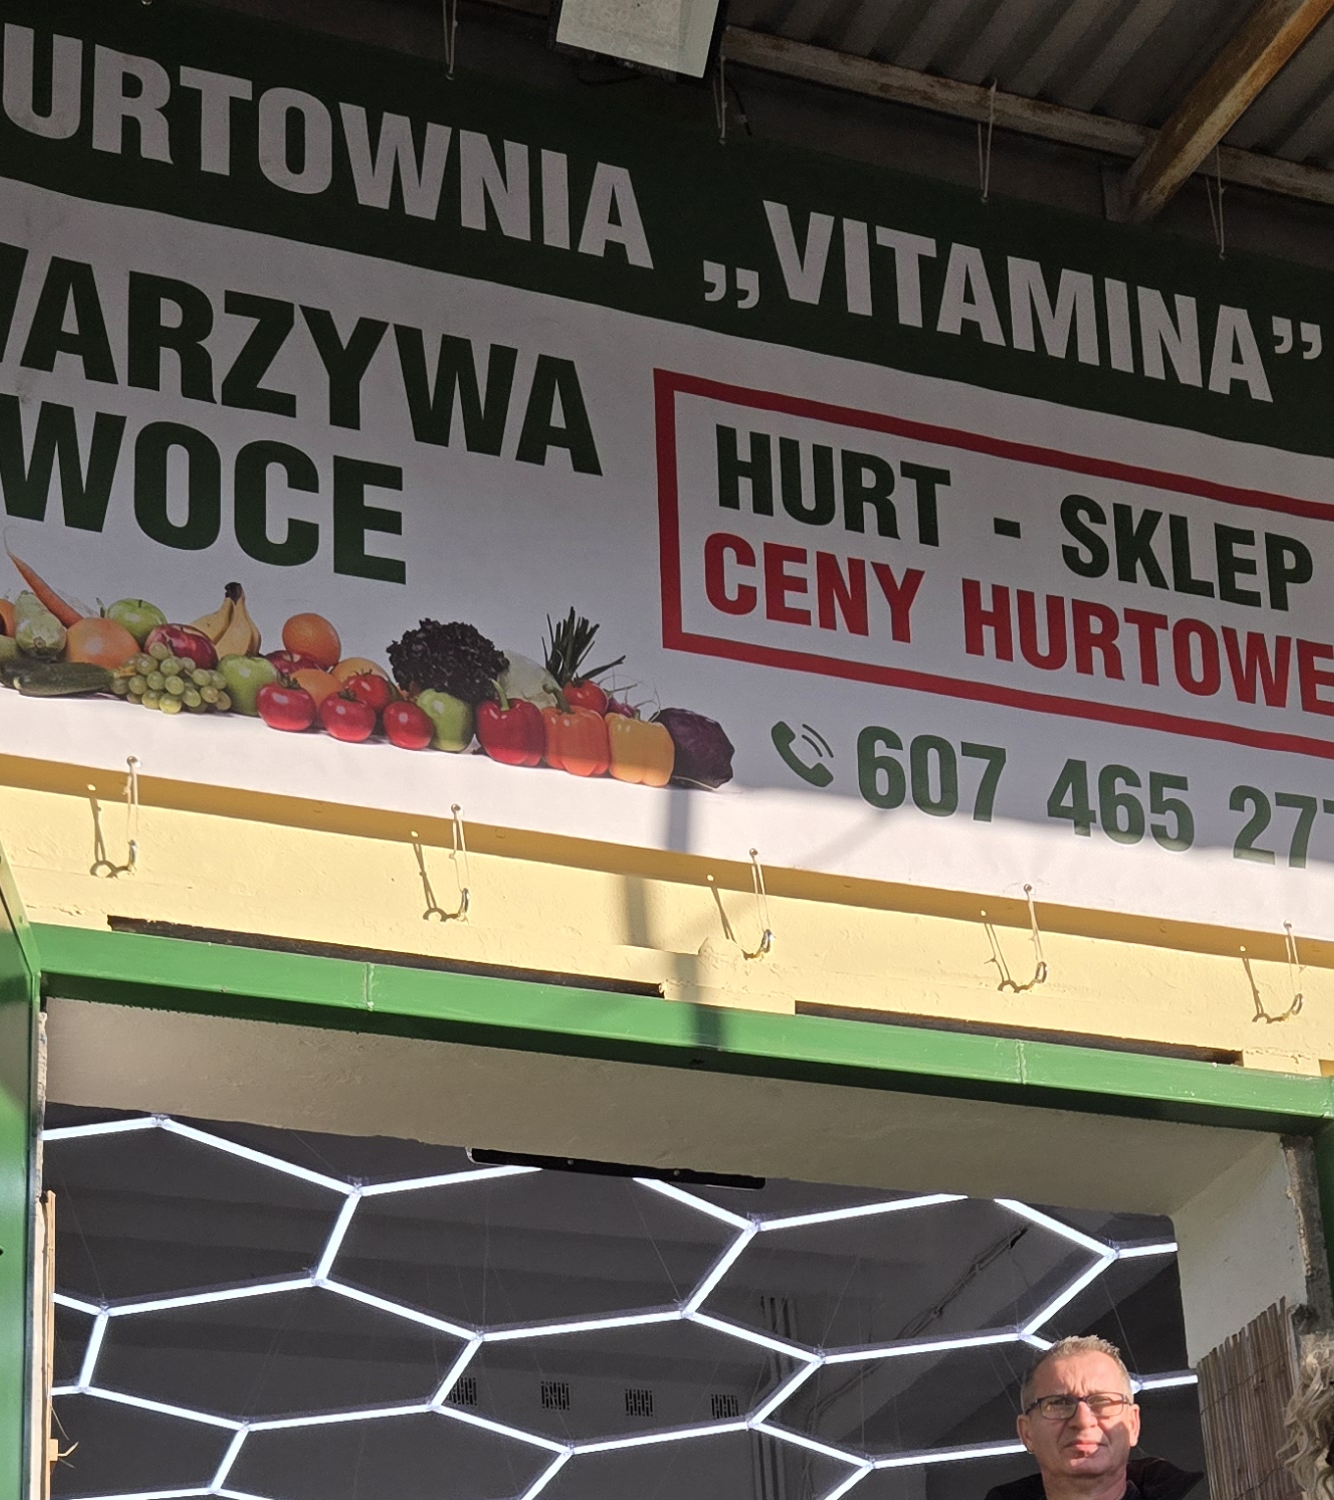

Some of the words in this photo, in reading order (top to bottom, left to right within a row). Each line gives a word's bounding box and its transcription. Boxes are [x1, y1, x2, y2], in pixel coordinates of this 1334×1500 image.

[716, 424, 951, 548] HURT
[1060, 494, 1314, 612] SKLEP
[704, 533, 926, 643] CENY
[857, 726, 1007, 824] 607
[1047, 760, 1196, 853] 465
